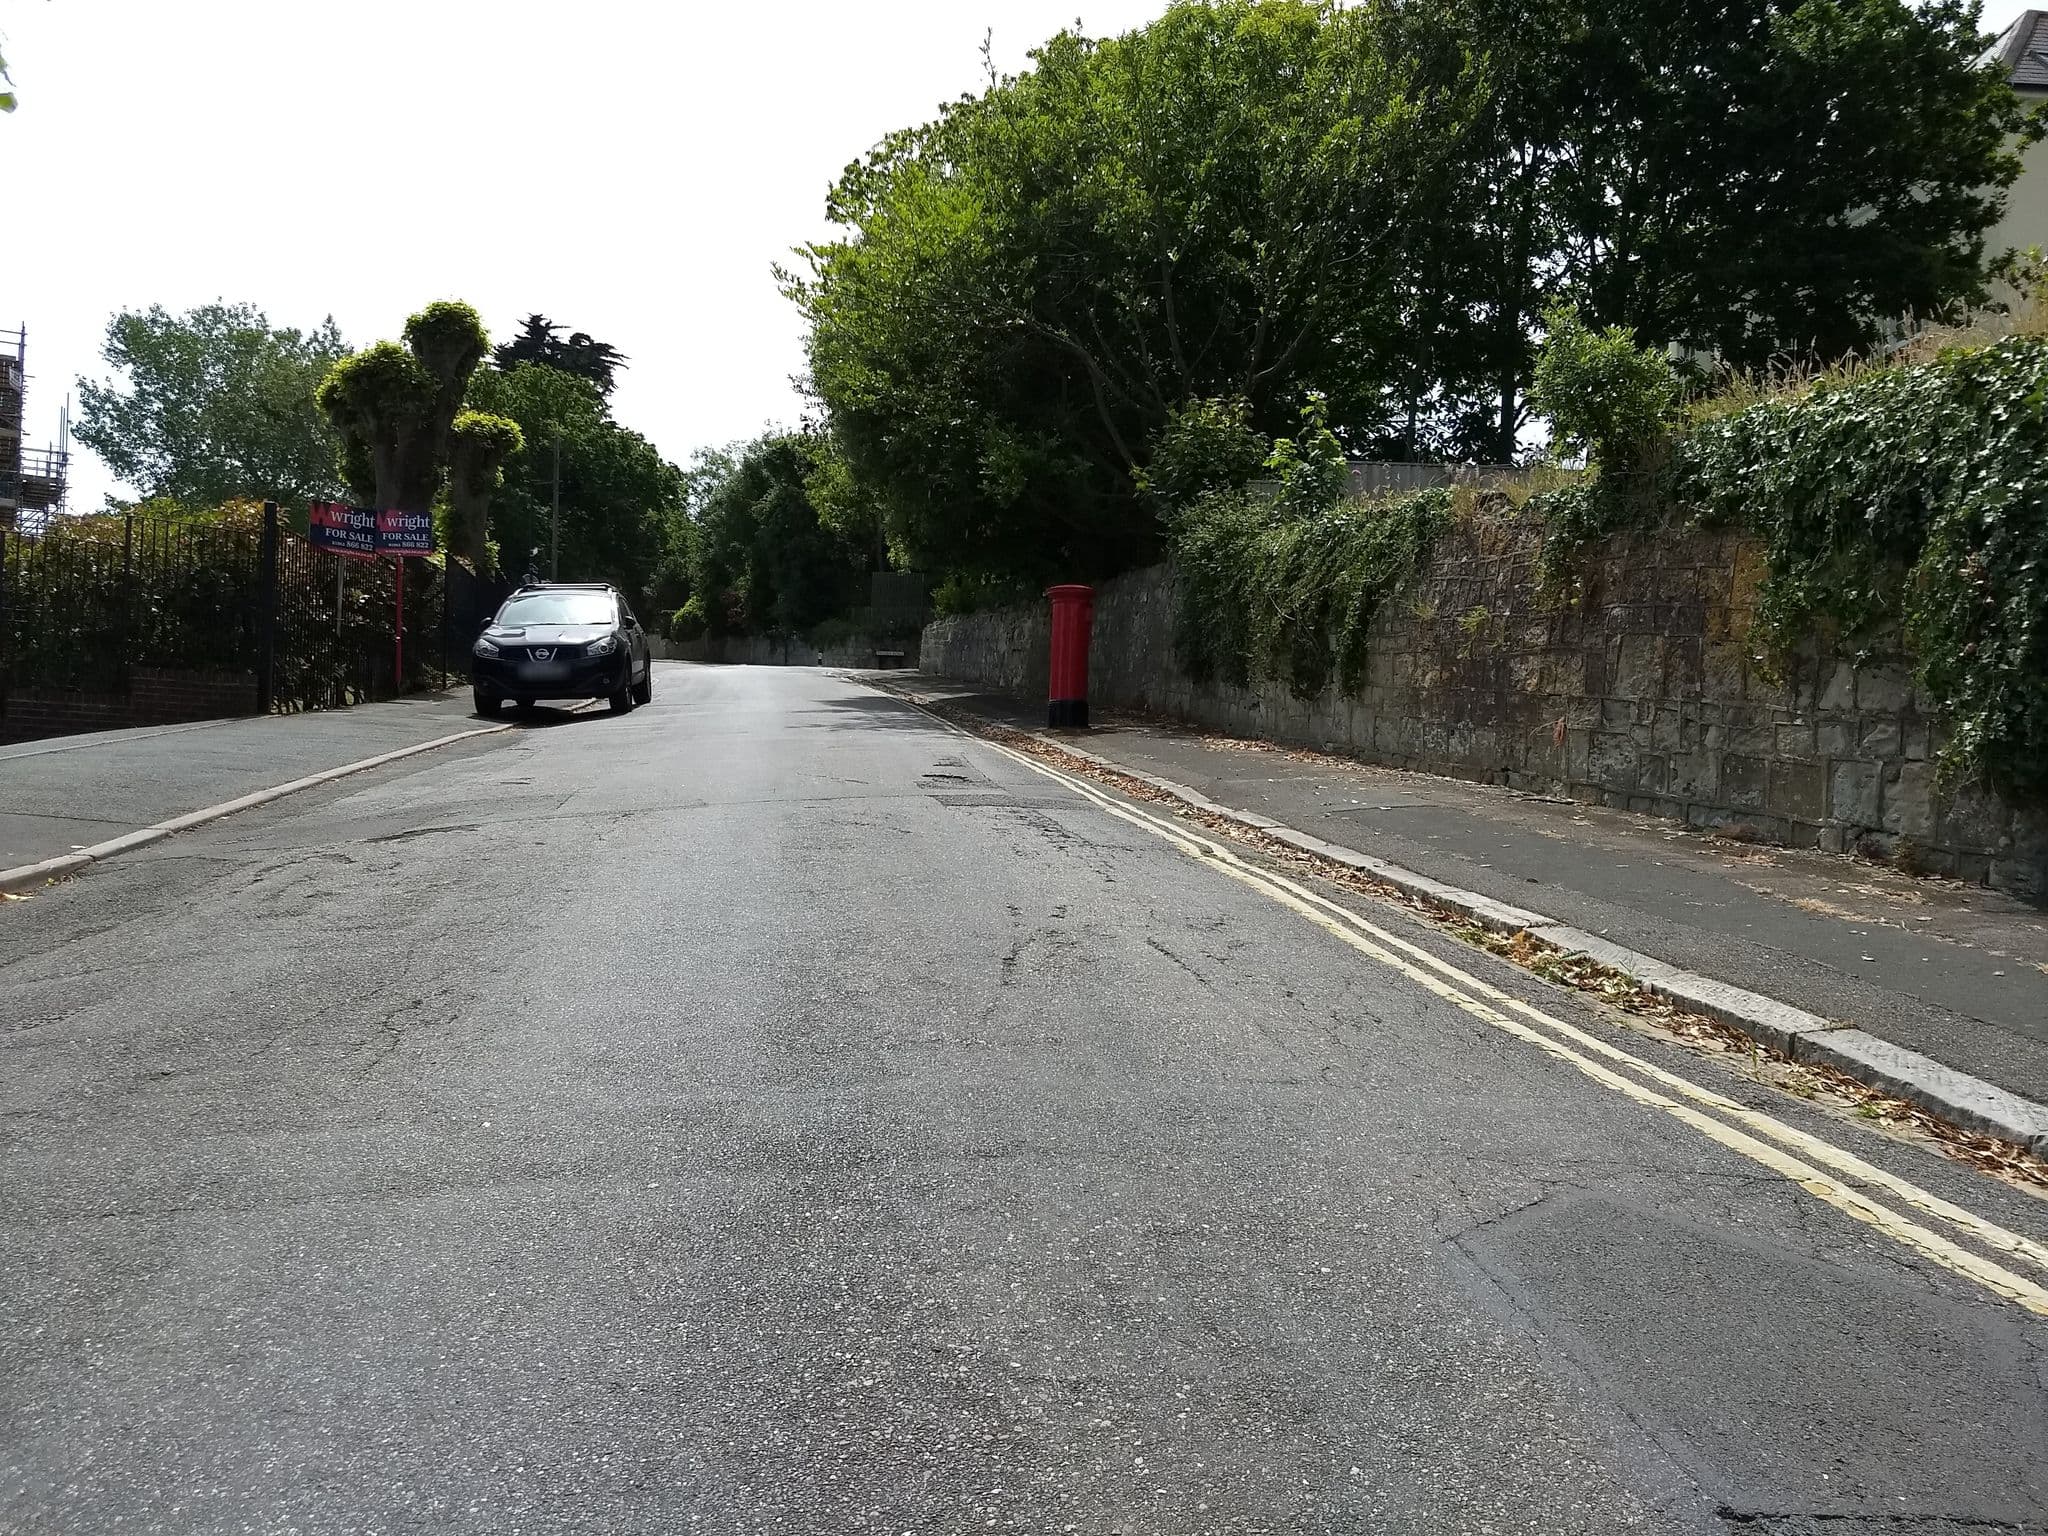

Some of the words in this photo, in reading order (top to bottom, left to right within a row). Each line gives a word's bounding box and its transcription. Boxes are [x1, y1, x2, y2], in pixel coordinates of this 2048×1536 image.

[331, 511, 375, 529] wright
[386, 515, 430, 530] wright
[326, 528, 347, 539] FOR
[349, 531, 374, 543] SALE
[404, 533, 429, 541] SALE
